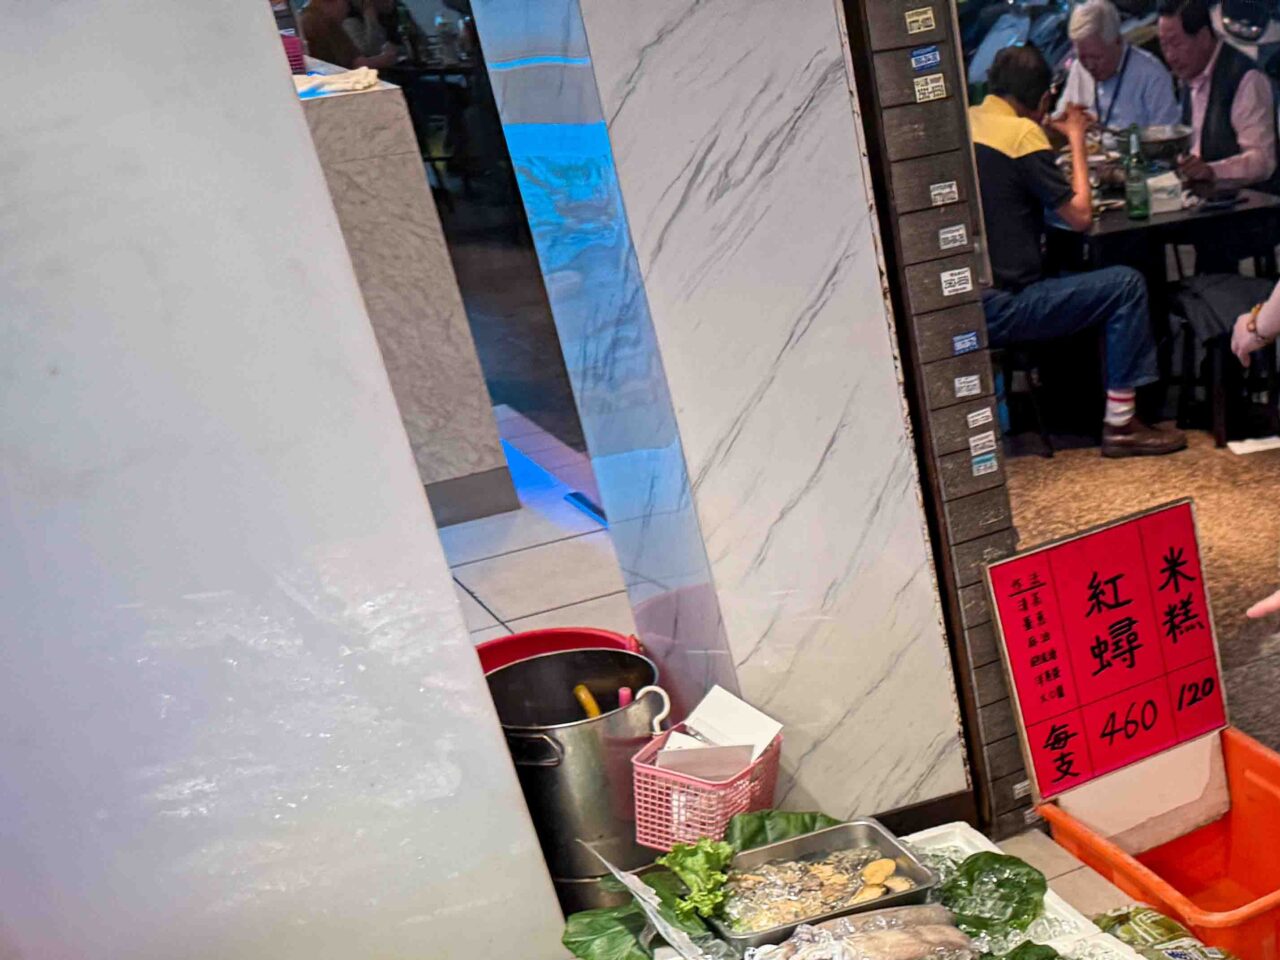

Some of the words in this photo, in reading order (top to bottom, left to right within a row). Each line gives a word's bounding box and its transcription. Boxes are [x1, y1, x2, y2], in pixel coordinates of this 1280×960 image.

[1085, 571, 1143, 677] 紅蟳
[1158, 546, 1205, 644] 米糕
[1100, 699, 1158, 746] 460
[1177, 676, 1215, 712] 120
[1042, 723, 1080, 783] 每支
